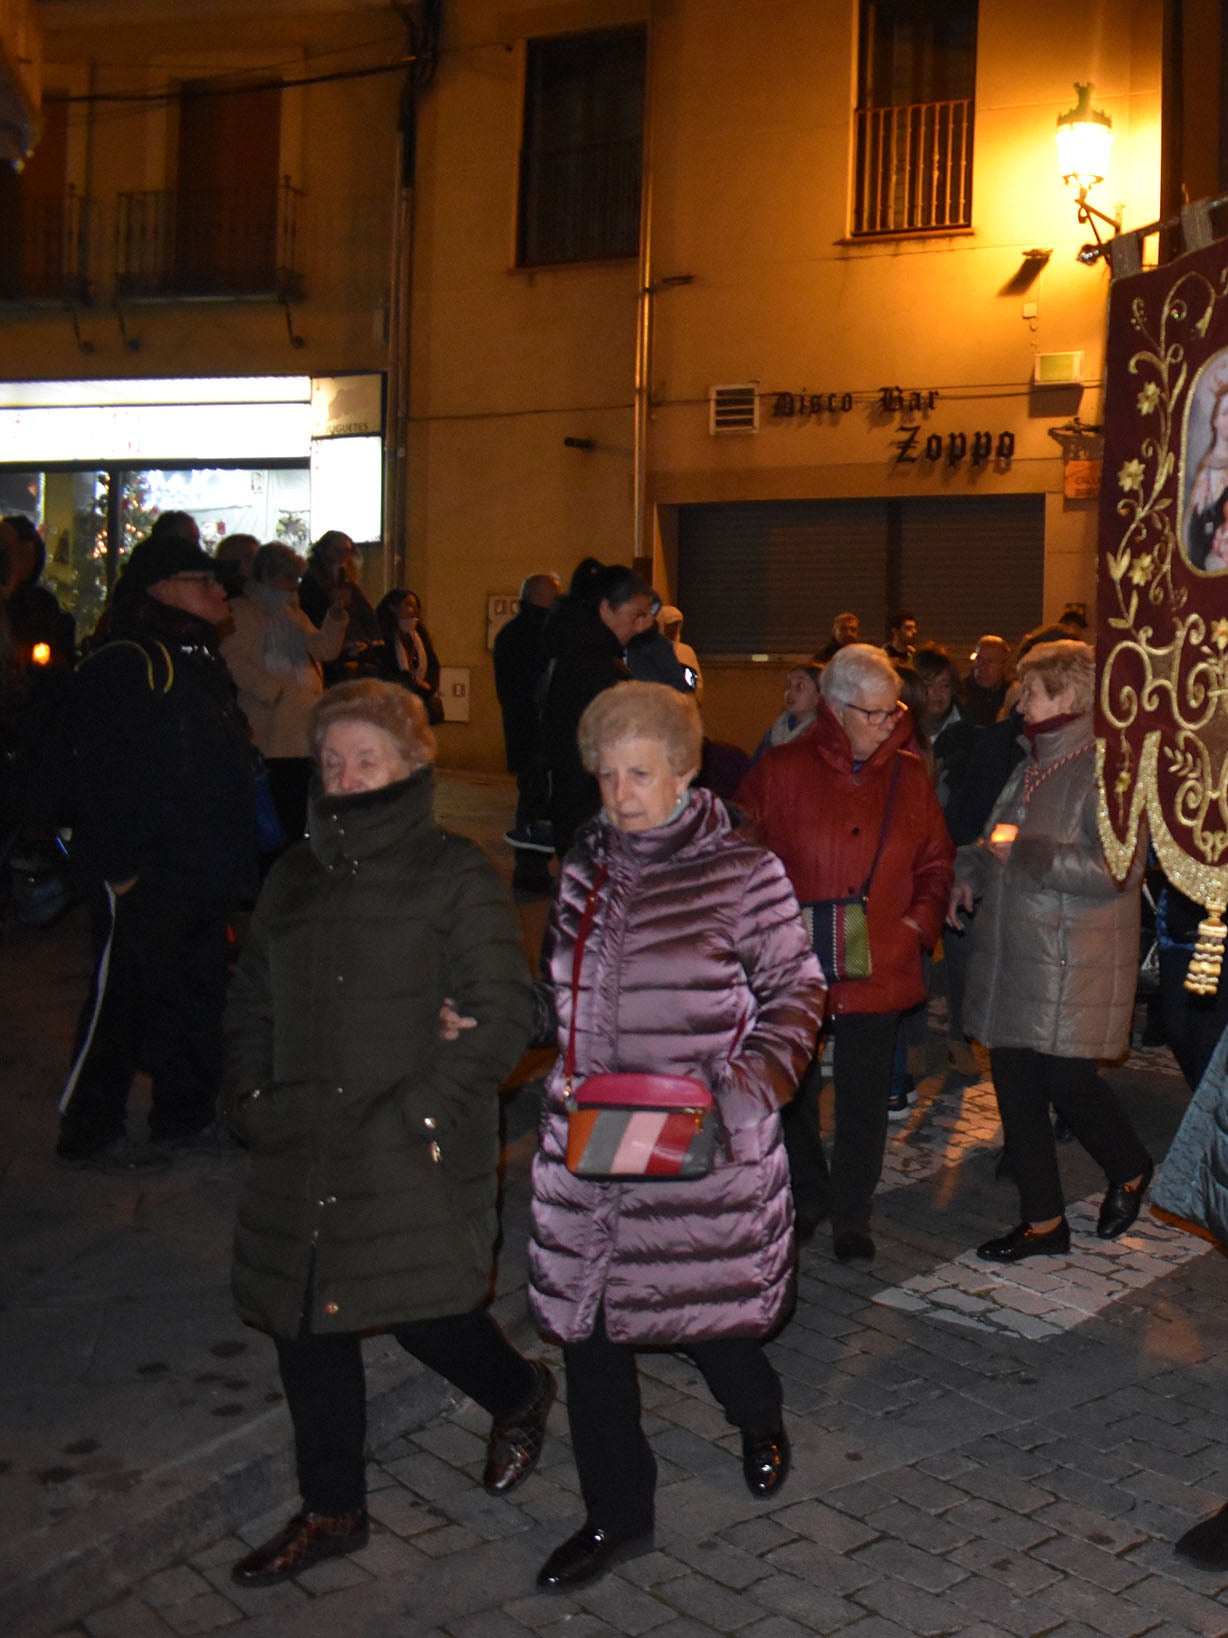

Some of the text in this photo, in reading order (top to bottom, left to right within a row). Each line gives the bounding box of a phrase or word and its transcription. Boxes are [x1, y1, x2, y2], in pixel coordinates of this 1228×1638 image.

[773, 386, 940, 417] Disco Bar
[895, 425, 1016, 469] Zoppo
